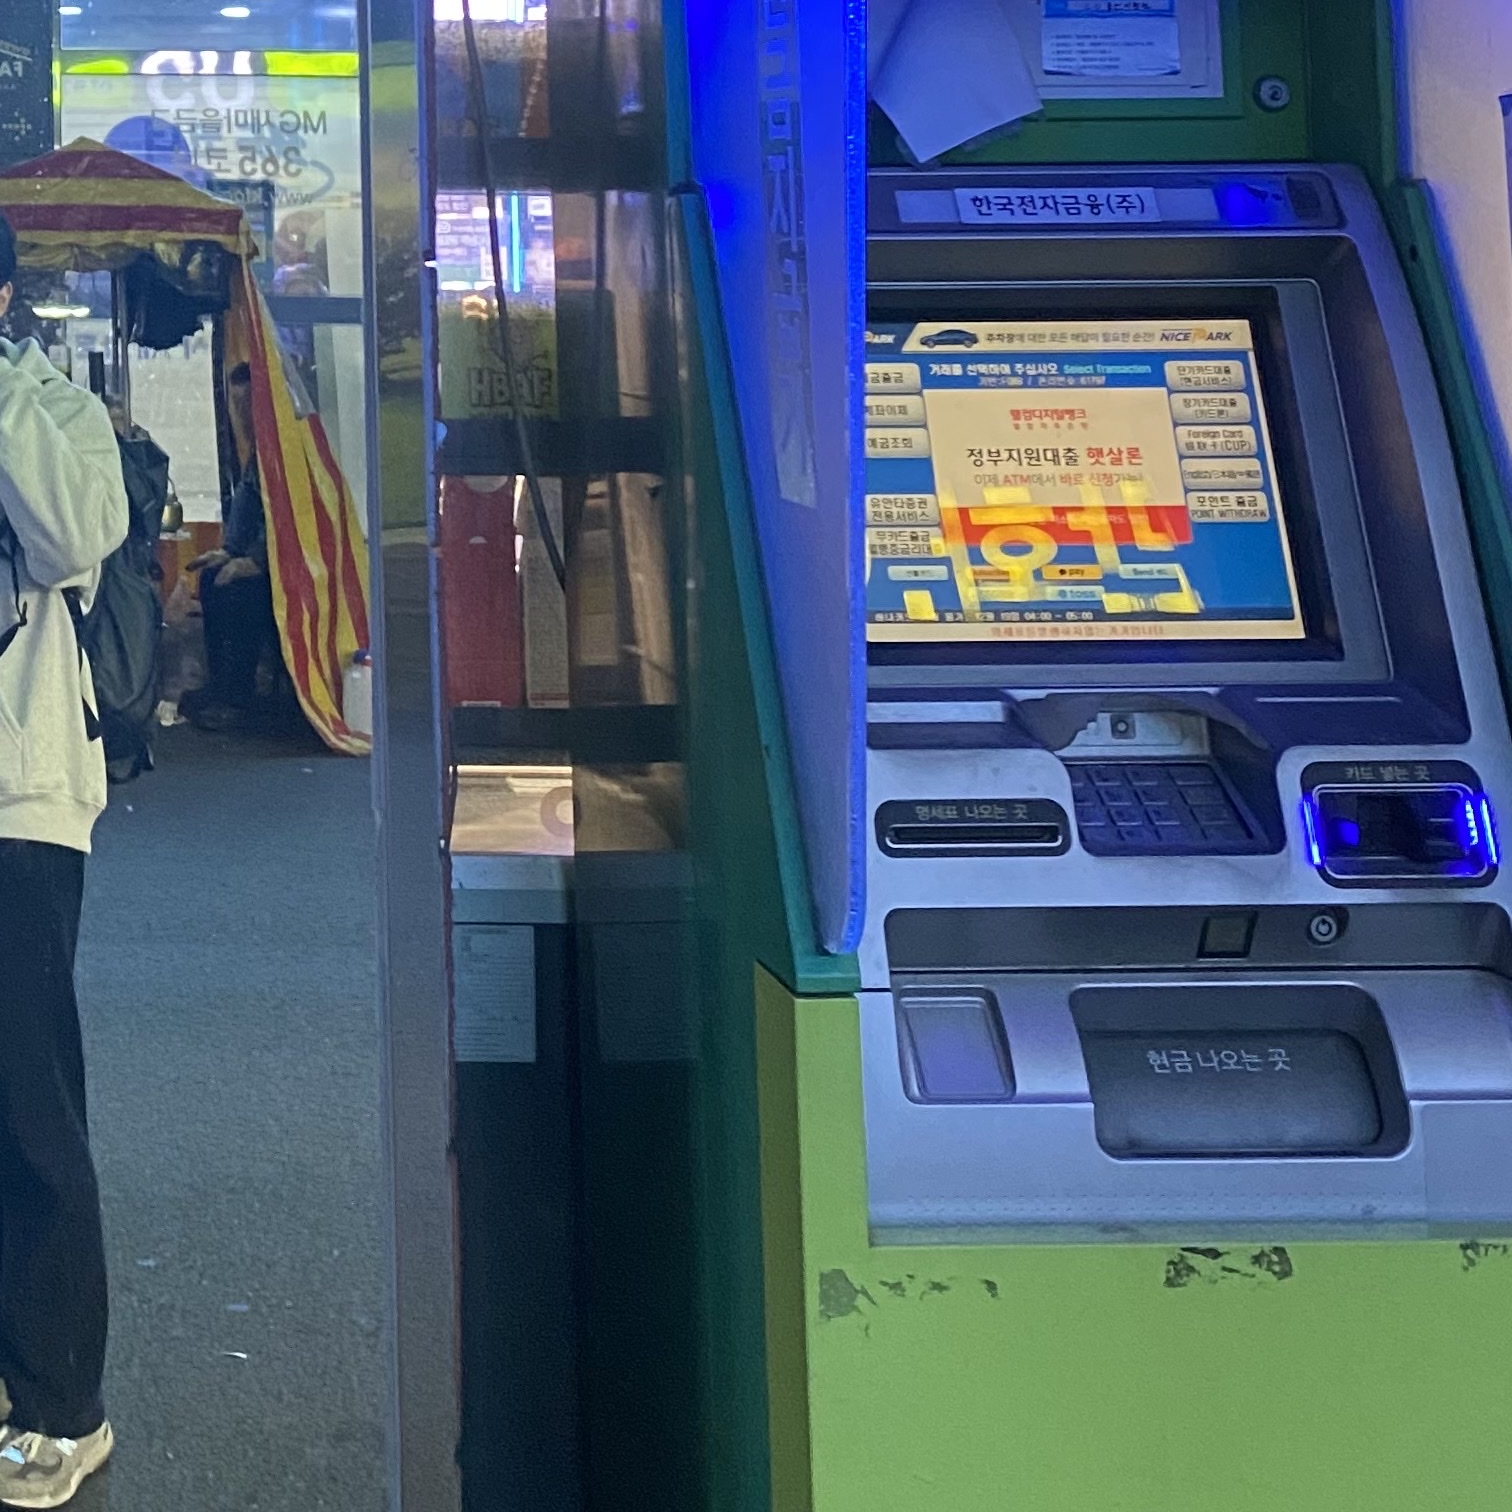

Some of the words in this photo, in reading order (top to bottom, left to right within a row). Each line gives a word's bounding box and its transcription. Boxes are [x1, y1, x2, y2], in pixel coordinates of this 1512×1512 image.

[140, 51, 256, 107] CU
[969, 194, 1146, 218] 한국전자금융(주)
[985, 333, 1025, 343] 주차장에
[1028, 333, 1046, 342] 대한
[1102, 332, 1129, 342] 필요한
[929, 364, 962, 376] 거래를
[967, 364, 1011, 376] 선택하여
[1015, 363, 1059, 375] 주십시오
[1177, 366, 1231, 375] 단기카드대출
[469, 368, 553, 407] HBAF
[1183, 399, 1237, 408] 장기카드대출
[1188, 430, 1221, 439] Foreign
[1223, 430, 1243, 438] Card
[867, 438, 913, 449] 예금조회
[967, 447, 1080, 467] 정부지원대출
[1086, 446, 1144, 466] 햇살론
[975, 474, 999, 485] 이제
[1003, 474, 1057, 486] ATM에서
[1060, 473, 1085, 485] 바로
[870, 498, 927, 510] 유안타증권
[1197, 496, 1231, 507] 포인트
[1235, 496, 1258, 507] 출금
[871, 510, 930, 522] 전용서비스
[1191, 509, 1215, 518] POINT
[1218, 509, 1266, 518] WITHDRAW
[876, 531, 930, 542] 무카드출금
[1345, 764, 1375, 782] 카드
[1415, 763, 1432, 782] 곳
[915, 803, 959, 822] 명세표
[968, 803, 1008, 822] 나오는
[1013, 803, 1028, 821] 곳
[1147, 1049, 1191, 1074] 현금
[1197, 1049, 1262, 1074] 나오는
[1268, 1049, 1291, 1073] 곳
